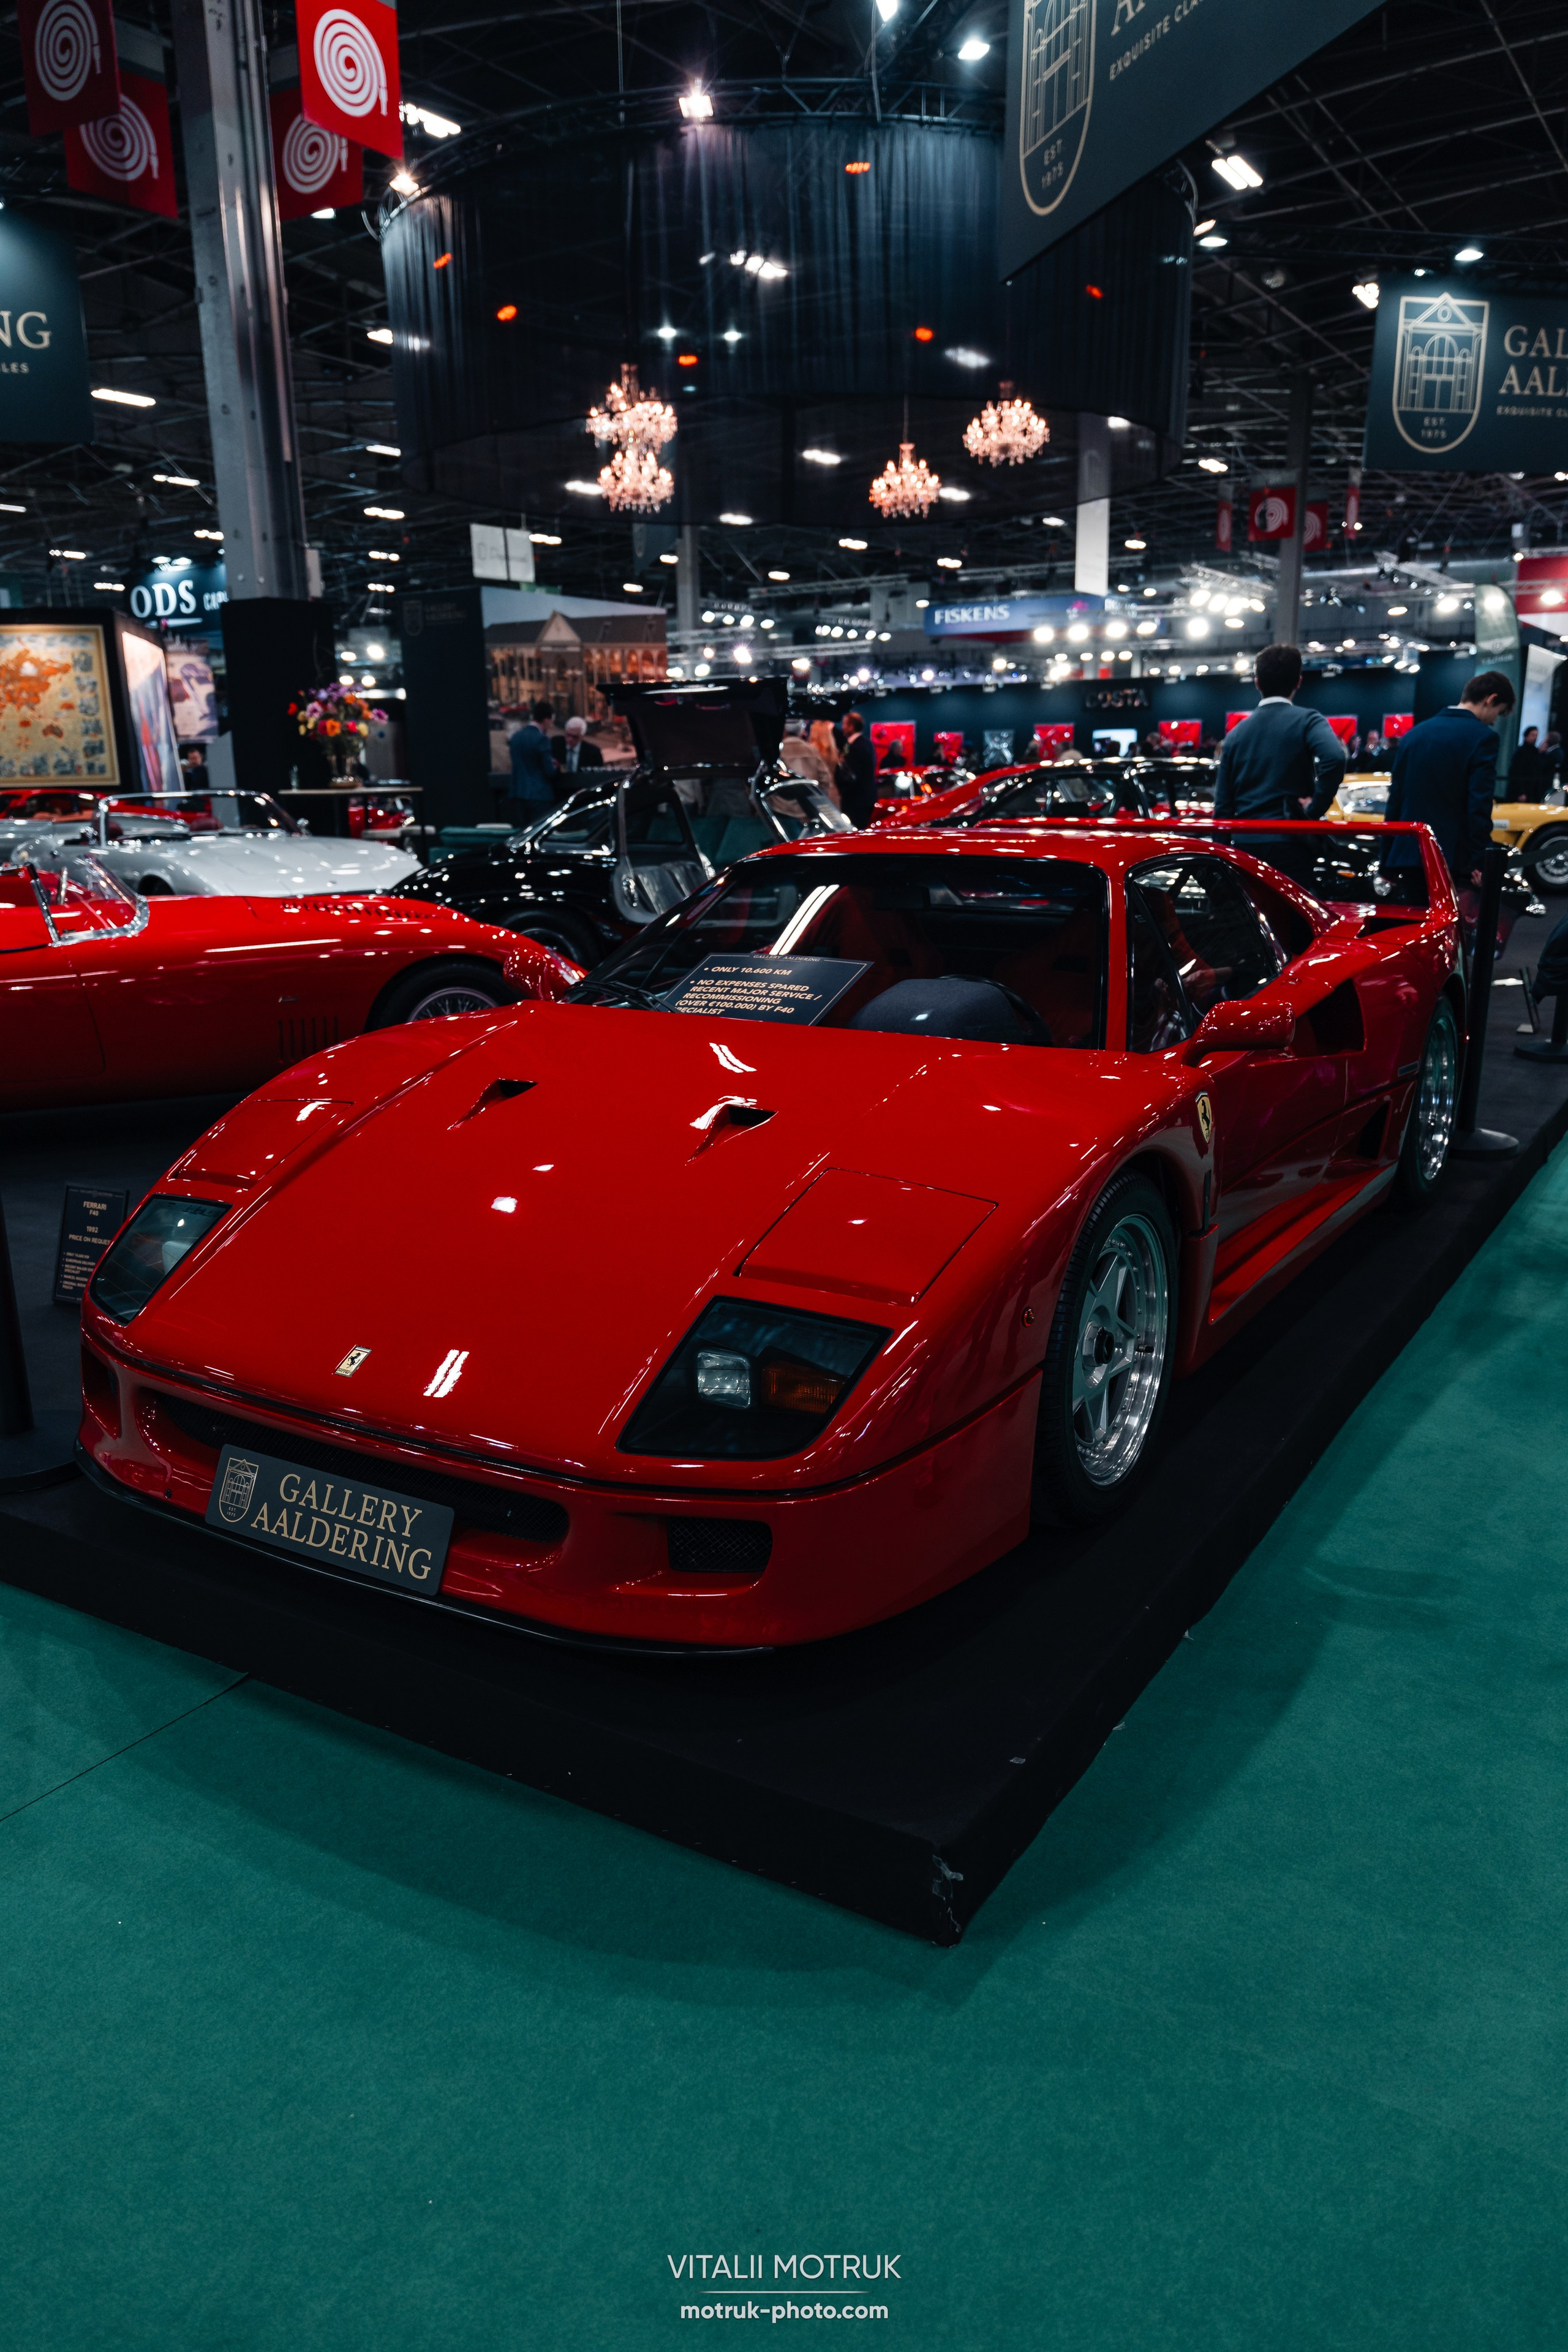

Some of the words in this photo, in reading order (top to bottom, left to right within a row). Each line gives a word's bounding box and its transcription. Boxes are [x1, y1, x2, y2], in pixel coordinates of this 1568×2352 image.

[1109, 15, 1170, 81] EXQUISITE
[1498, 364, 1568, 397] AAL
[130, 579, 196, 618] ODS
[934, 604, 1010, 625] FISKENS
[730, 987, 769, 996] MAJOR
[768, 990, 815, 1000] SERVICE
[767, 982, 810, 992] SPARED
[682, 993, 782, 1005] RECOMMISSIONING
[708, 1001, 757, 1011] €100.000)
[83, 1200, 107, 1211] FERRARI
[92, 1237, 111, 1245] REQUES
[279, 1473, 423, 1538] GALLERY
[251, 1502, 432, 1580] AALDERING
